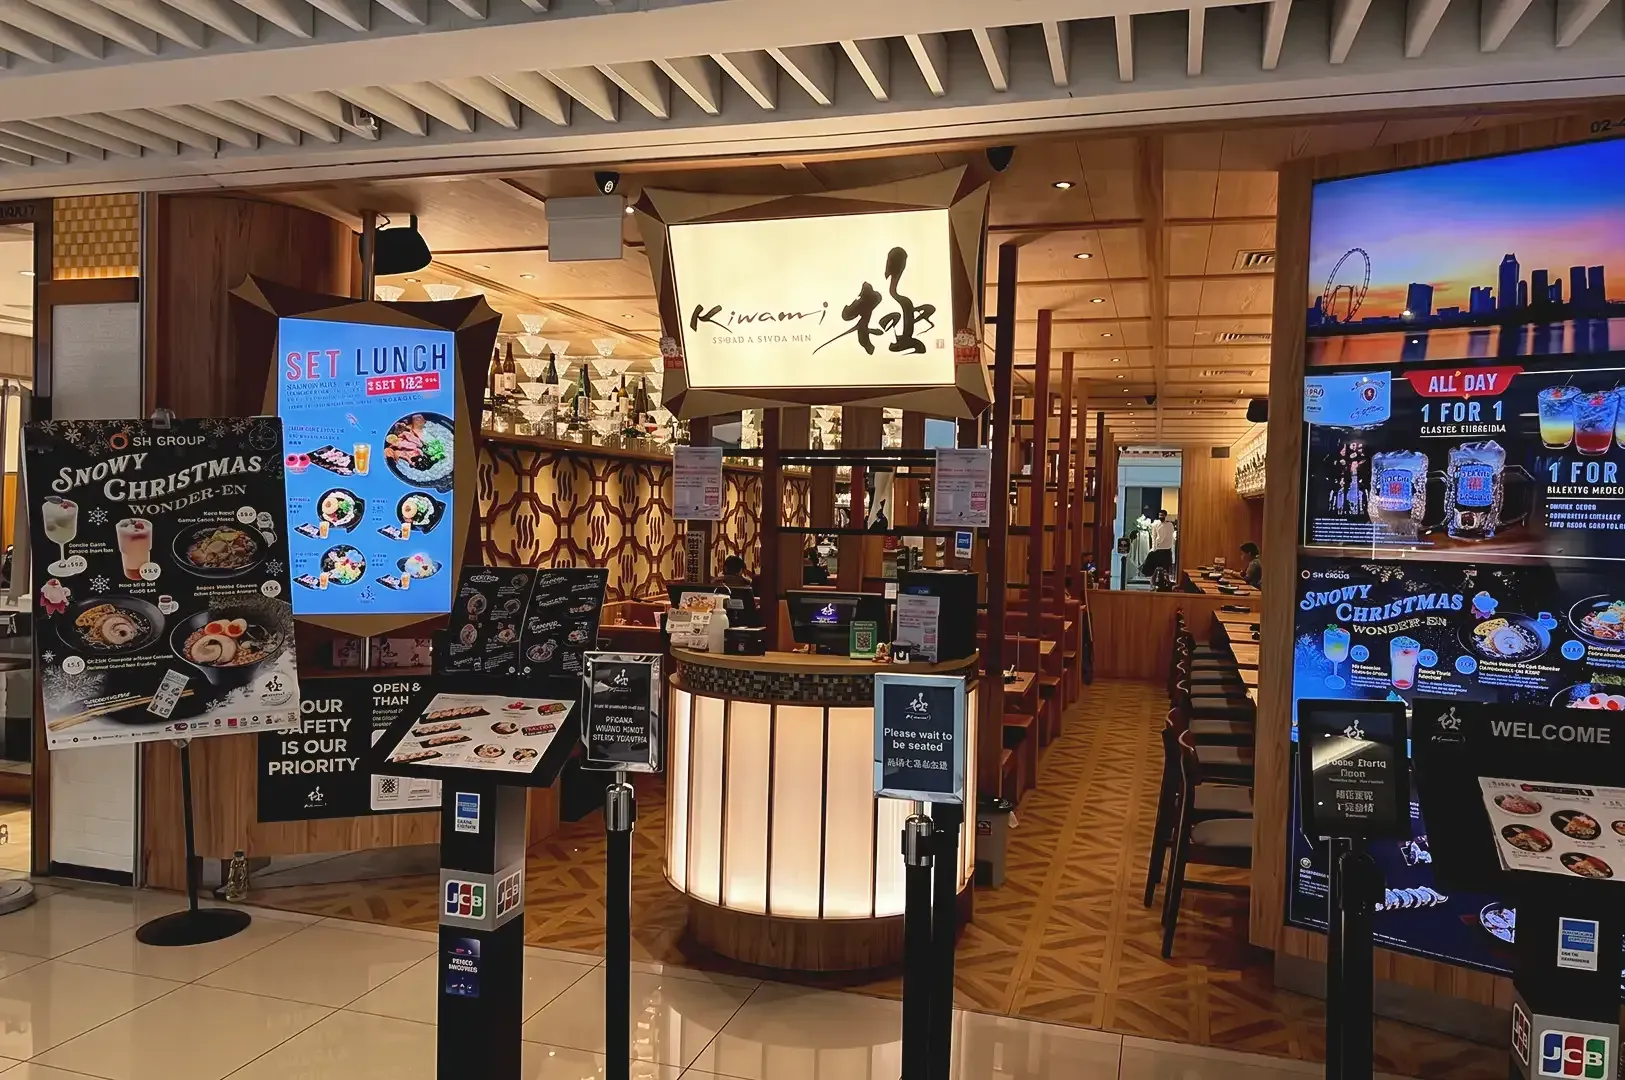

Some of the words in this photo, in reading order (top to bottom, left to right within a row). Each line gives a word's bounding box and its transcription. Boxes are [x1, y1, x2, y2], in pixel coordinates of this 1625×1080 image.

[690, 301, 829, 333] Kiwami
[286, 350, 341, 381] SET
[356, 343, 446, 376] LUNCH
[1428, 375, 1457, 393] ALL
[1463, 373, 1498, 392] DAY
[1420, 403, 1430, 423] 1
[1440, 401, 1482, 423] FOR
[1492, 400, 1503, 421] 1
[132, 436, 152, 447] SH
[156, 435, 206, 446] GROUP
[51, 452, 149, 493] SNOWY
[103, 455, 263, 502] CHRISTMAS
[1548, 461, 1559, 483] 1
[1570, 461, 1618, 484] FOR
[127, 484, 248, 515] WONDER-EN
[1300, 584, 1372, 611] SNOWY
[1336, 592, 1464, 622] CHRISTMAS
[373, 683, 409, 693] OPEN
[411, 682, 421, 692] &
[884, 728, 917, 738] Please
[919, 730, 940, 740] wait
[942, 731, 953, 740] to
[1491, 720, 1612, 744] WELCOME
[282, 741, 299, 755] IS
[303, 739, 347, 754] OUR
[893, 740, 906, 750] be
[908, 742, 943, 752] seated
[268, 757, 360, 776] PRIORITY
